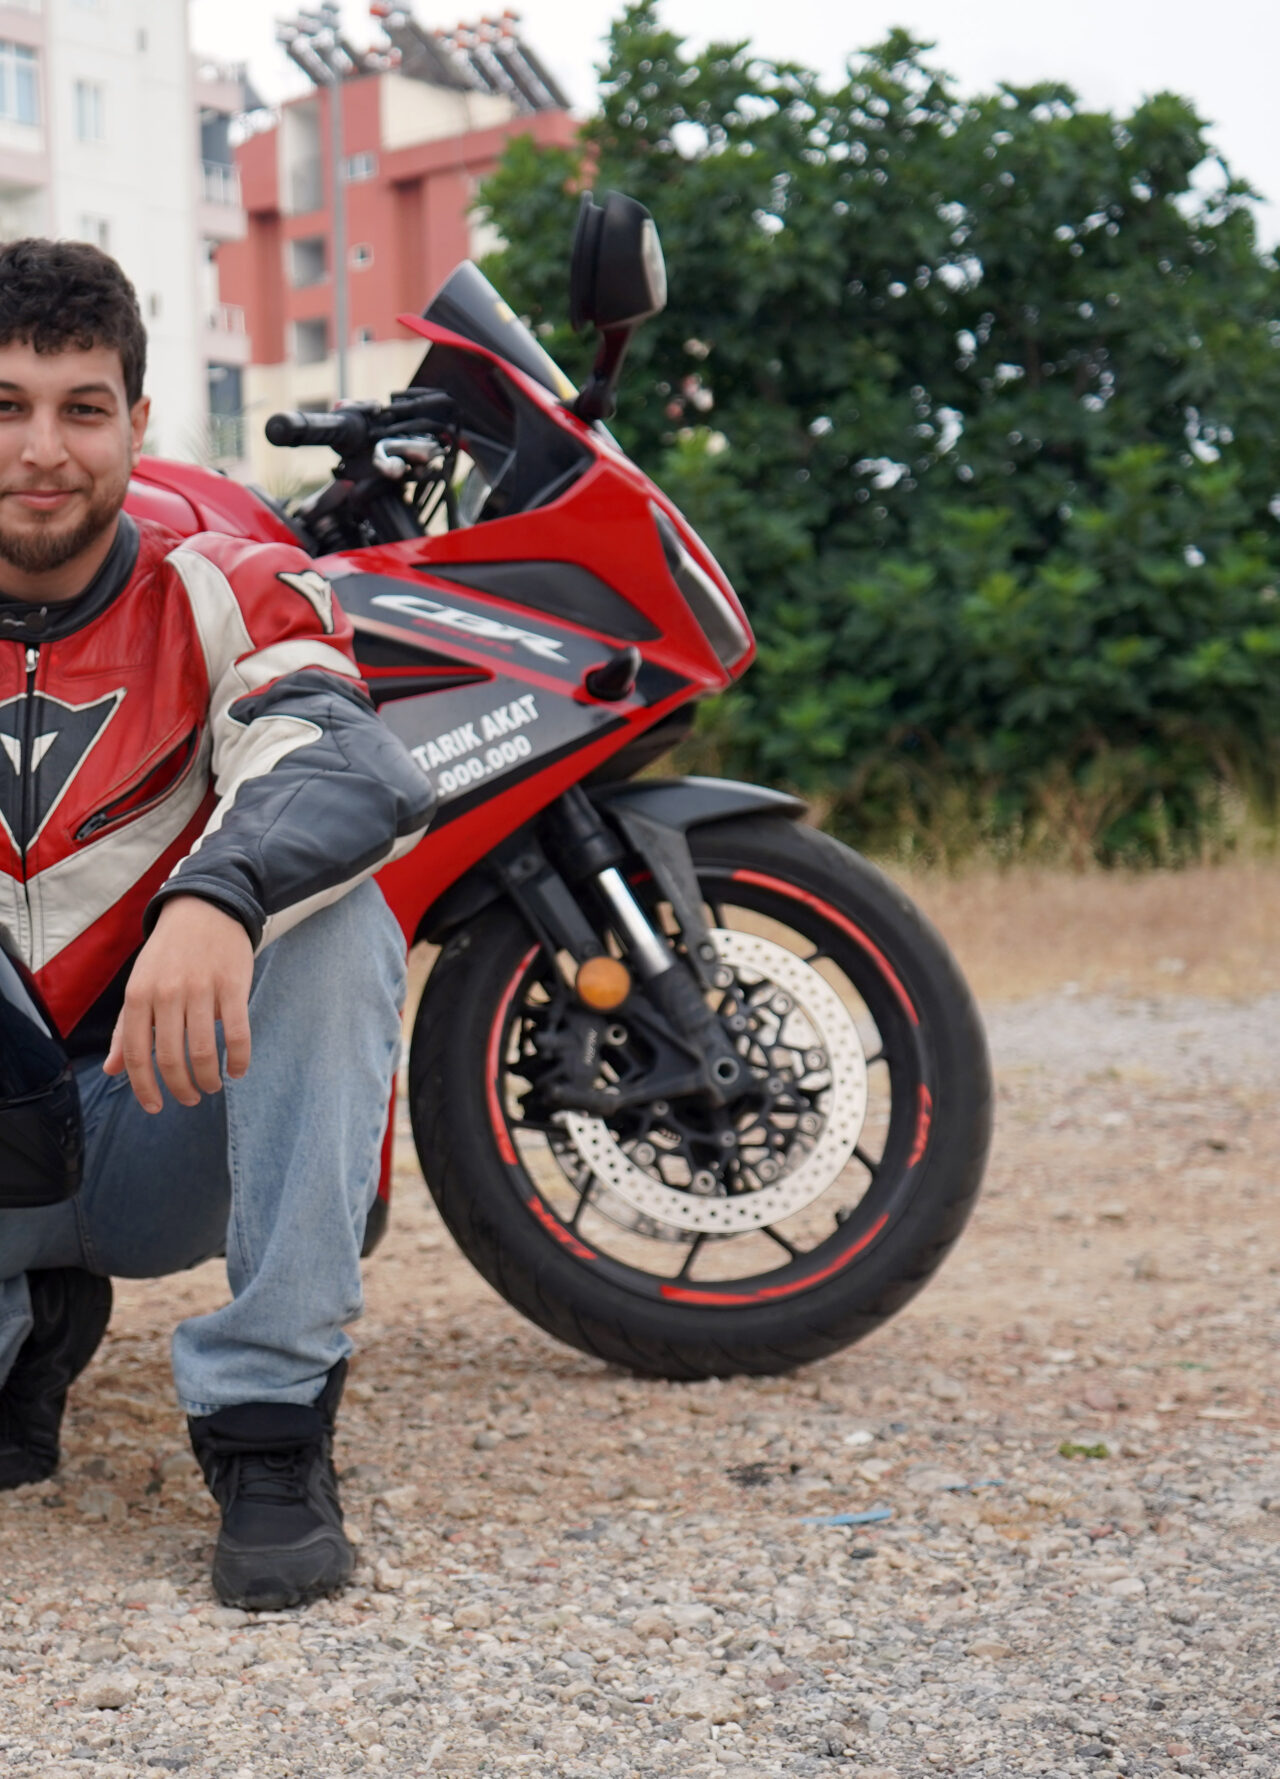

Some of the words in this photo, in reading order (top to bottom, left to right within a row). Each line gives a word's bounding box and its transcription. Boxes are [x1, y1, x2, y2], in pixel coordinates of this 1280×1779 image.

[370, 595, 568, 664] CBR
[411, 722, 483, 772] TARIK
[480, 693, 539, 742] AKAT
